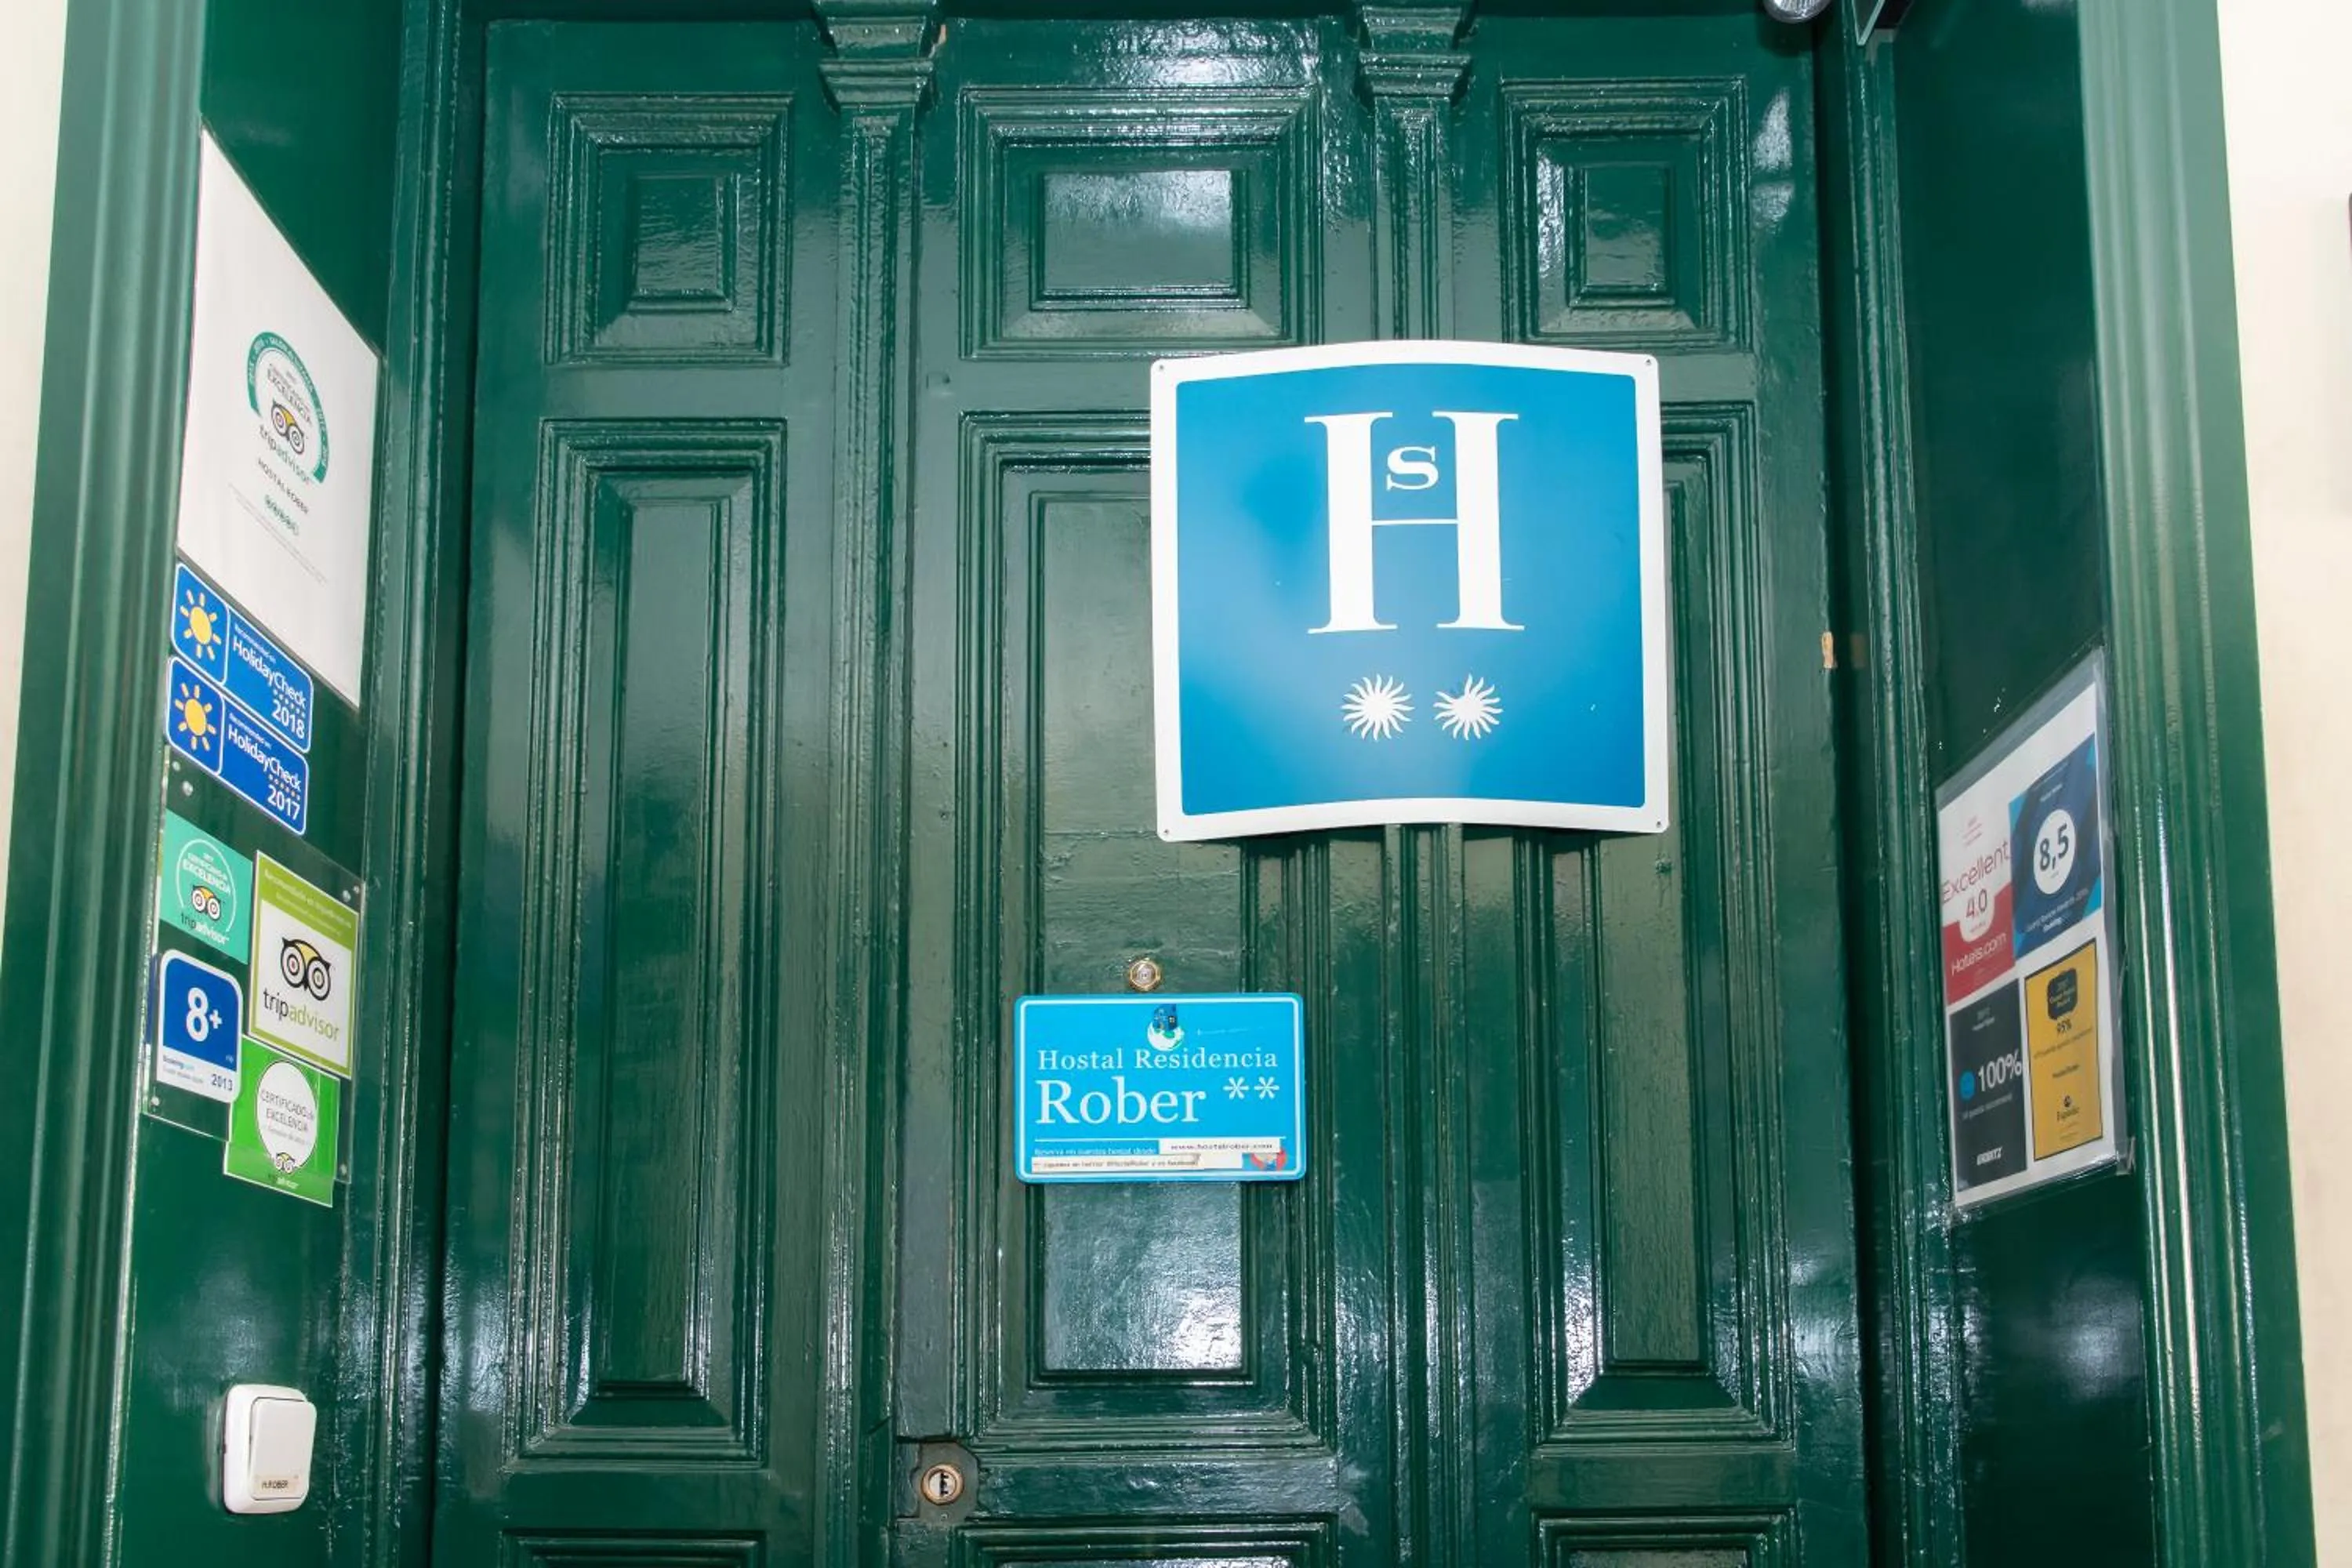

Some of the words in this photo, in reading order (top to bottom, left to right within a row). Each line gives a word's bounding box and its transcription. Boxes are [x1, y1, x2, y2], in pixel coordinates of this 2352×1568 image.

[1304, 411, 1524, 634] H
[233, 633, 307, 708] HolidayCheck
[271, 699, 305, 739] 2018
[228, 724, 302, 792] HolidayCheck
[267, 784, 300, 820] 2017
[2039, 822, 2069, 871] 8,5
[1942, 840, 2010, 904] Excellent
[1951, 932, 2007, 976] Hotels.com
[186, 986, 223, 1043] 8+
[263, 986, 339, 1041] tripadvisor
[1037, 1048, 1123, 1071] Hostal
[1134, 1047, 1278, 1069] Residencia
[1978, 1048, 2024, 1093] 100%
[1035, 1076, 1207, 1124] Rober
